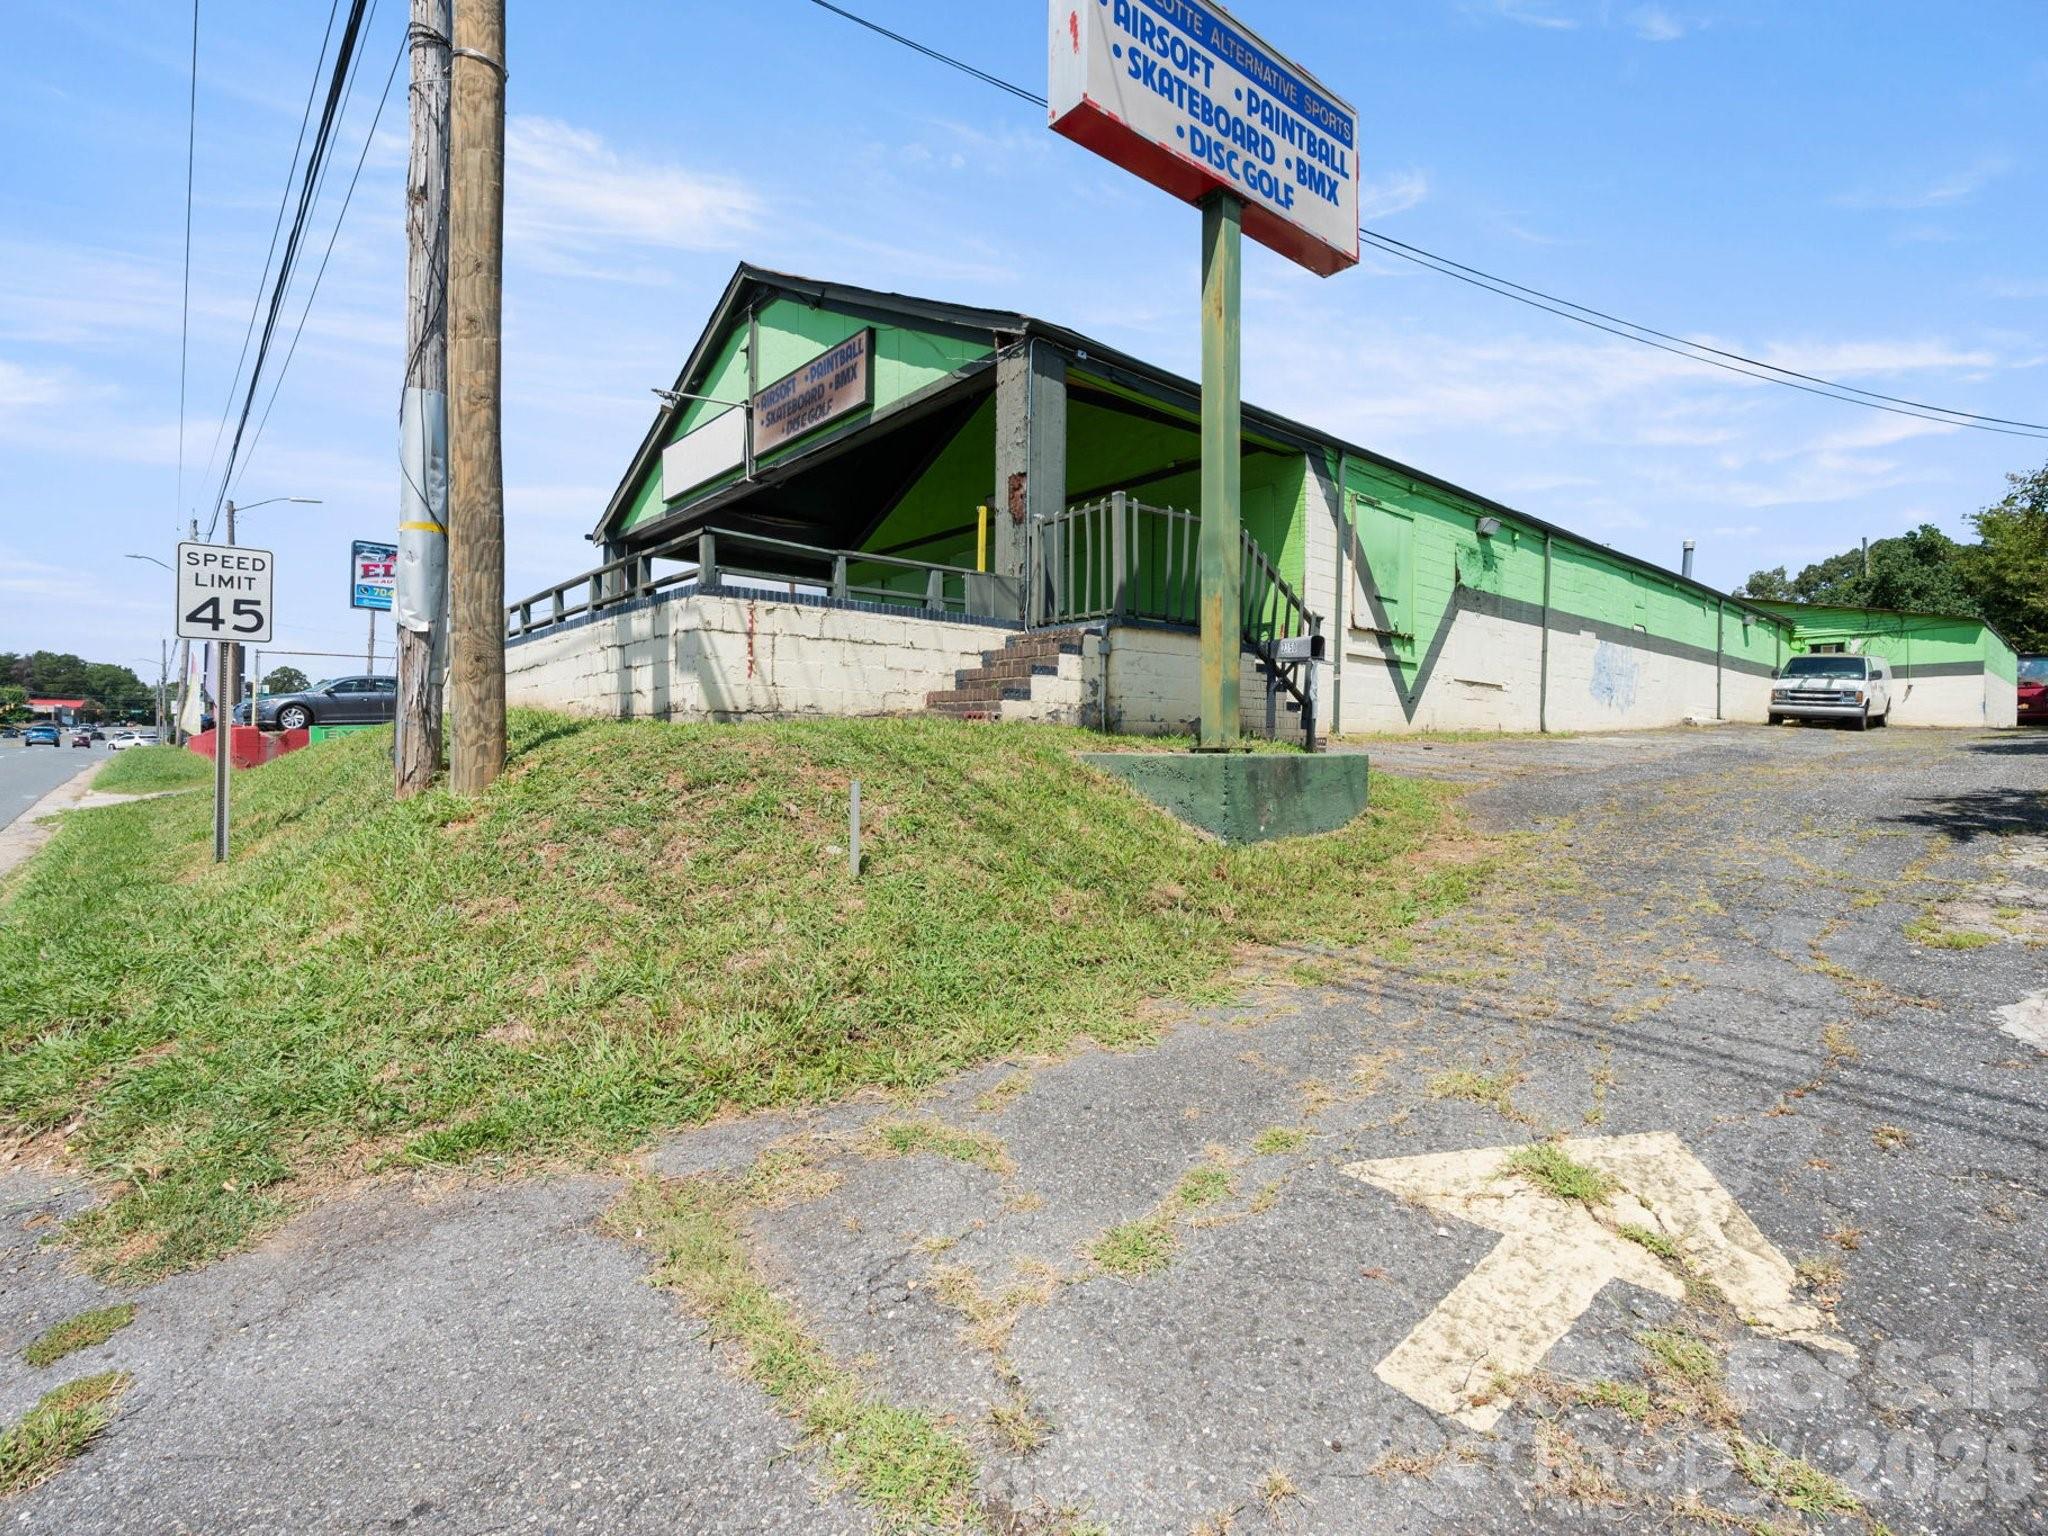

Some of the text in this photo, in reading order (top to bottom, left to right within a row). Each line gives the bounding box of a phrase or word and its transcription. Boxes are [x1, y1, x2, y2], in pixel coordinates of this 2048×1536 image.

[1113, 0, 1350, 180] AIRSOFT PAINTBALL
[1211, 27, 1297, 103] ALTERNATIVE
[1303, 94, 1351, 141] SPORTS
[1128, 46, 1340, 207] SKATEBOARD BMX
[1190, 124, 1294, 211] DISC GOLF
[761, 338, 864, 411] AIRSOFT PAINTBALL
[766, 361, 858, 428] SKATEBOARD BMX
[808, 398, 833, 424] GOLF
[186, 551, 266, 572] SPEED
[195, 572, 257, 591] LIMIT
[185, 596, 265, 633] 45
